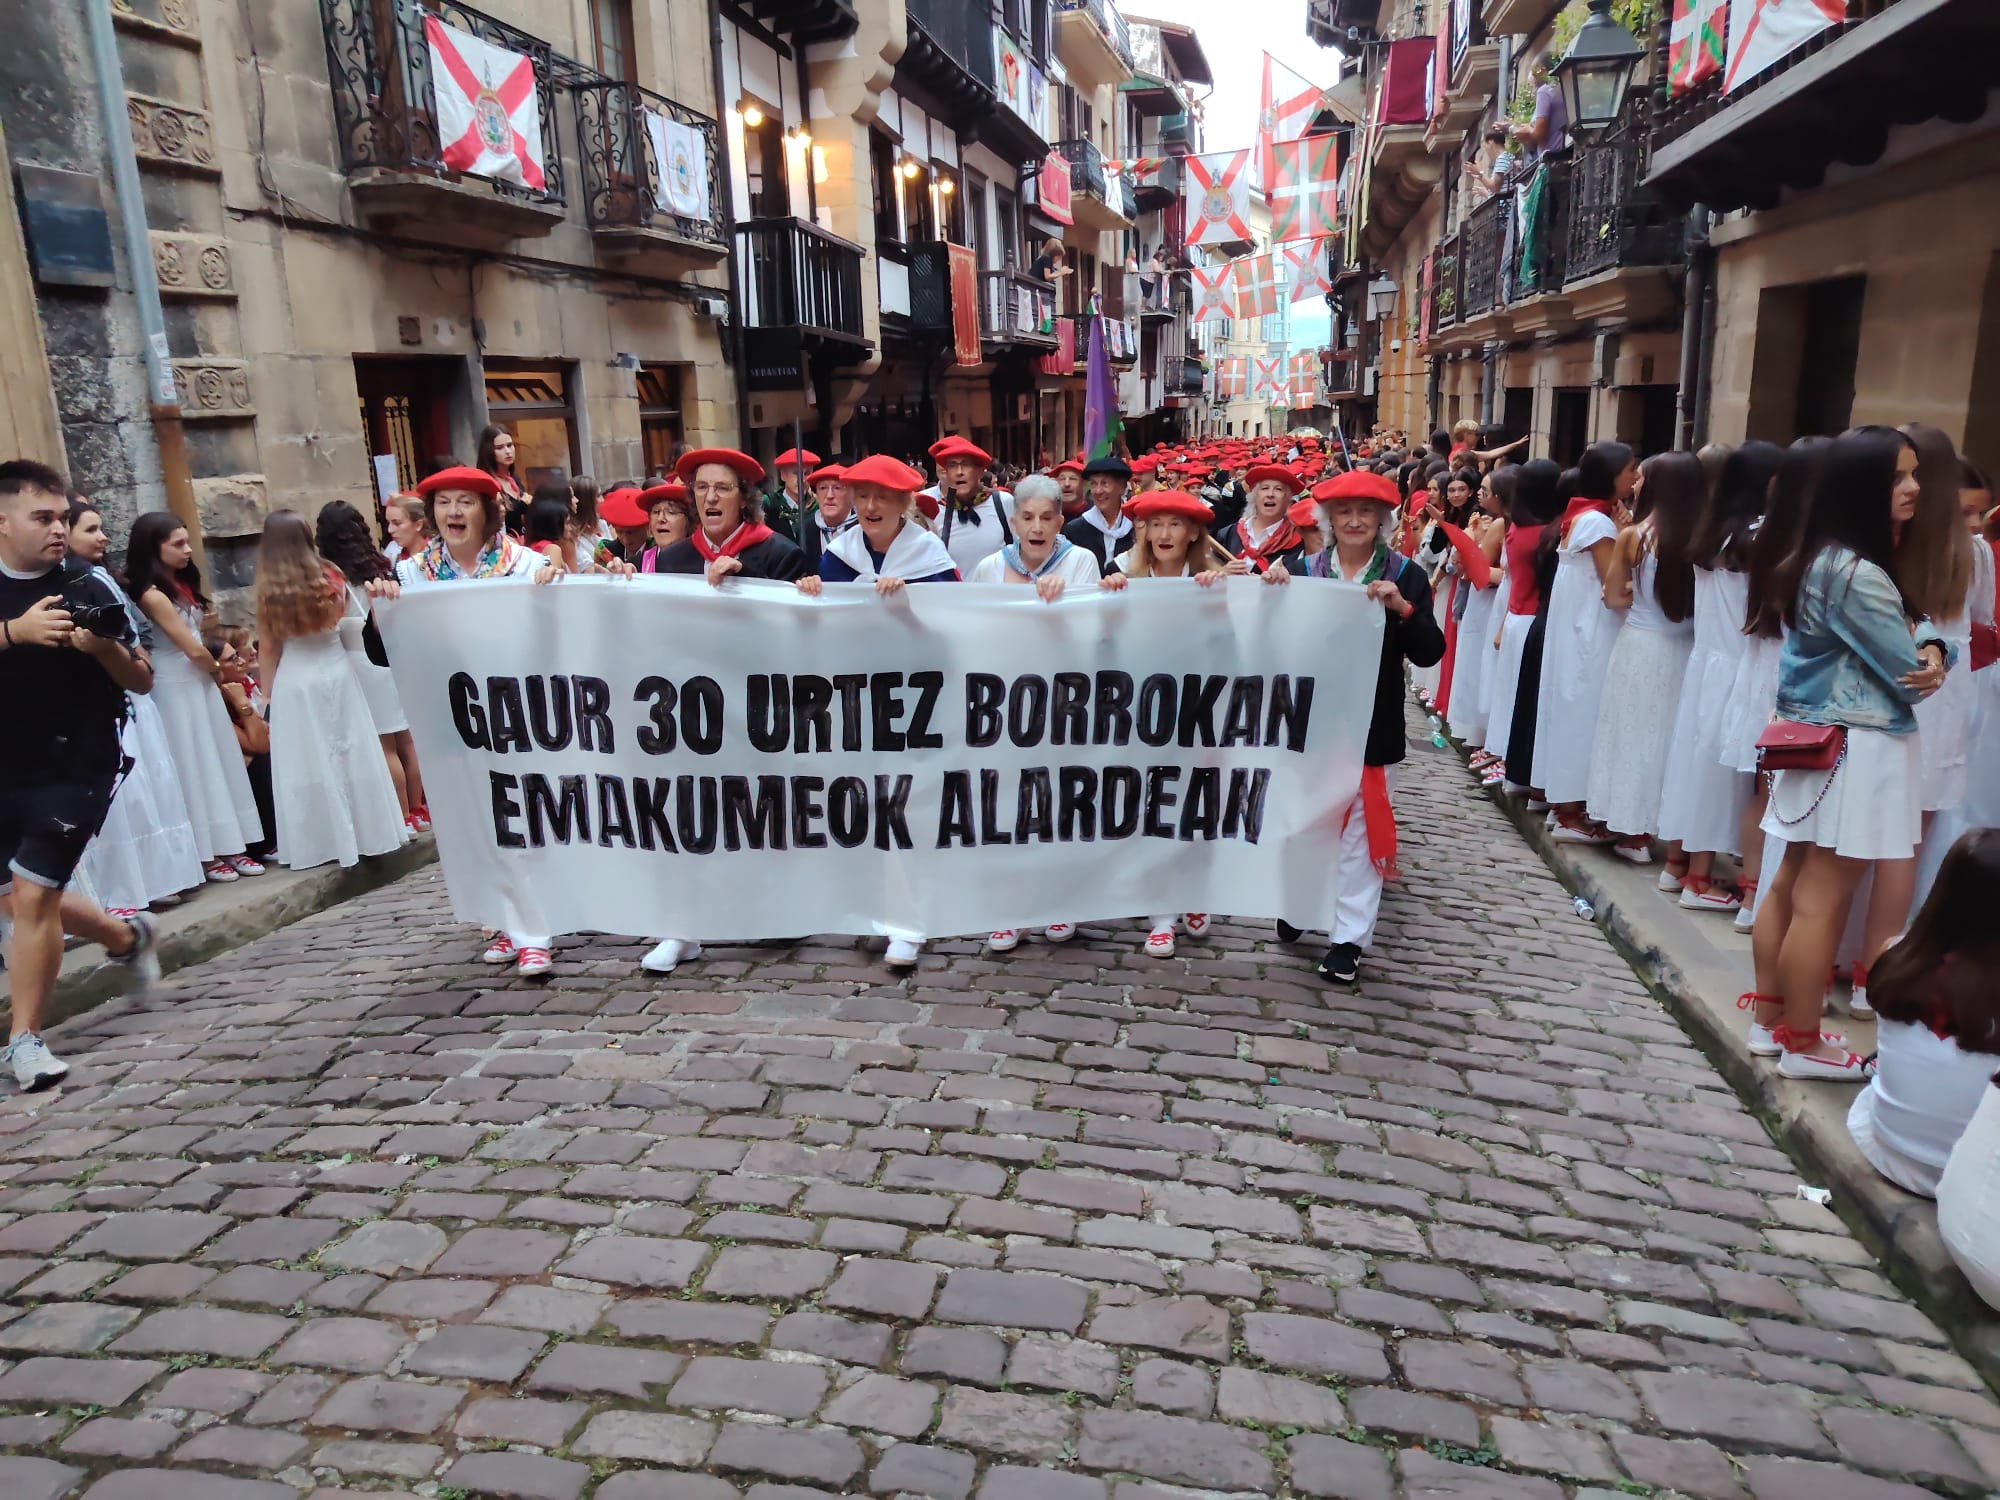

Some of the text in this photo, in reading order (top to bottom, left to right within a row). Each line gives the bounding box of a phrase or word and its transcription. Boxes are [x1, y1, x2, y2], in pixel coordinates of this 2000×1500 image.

[448, 670, 1315, 755] GAUR 30 URTEZ BORROKAN
[488, 765, 1272, 855] EMAKUMEOK ALARDEAN
